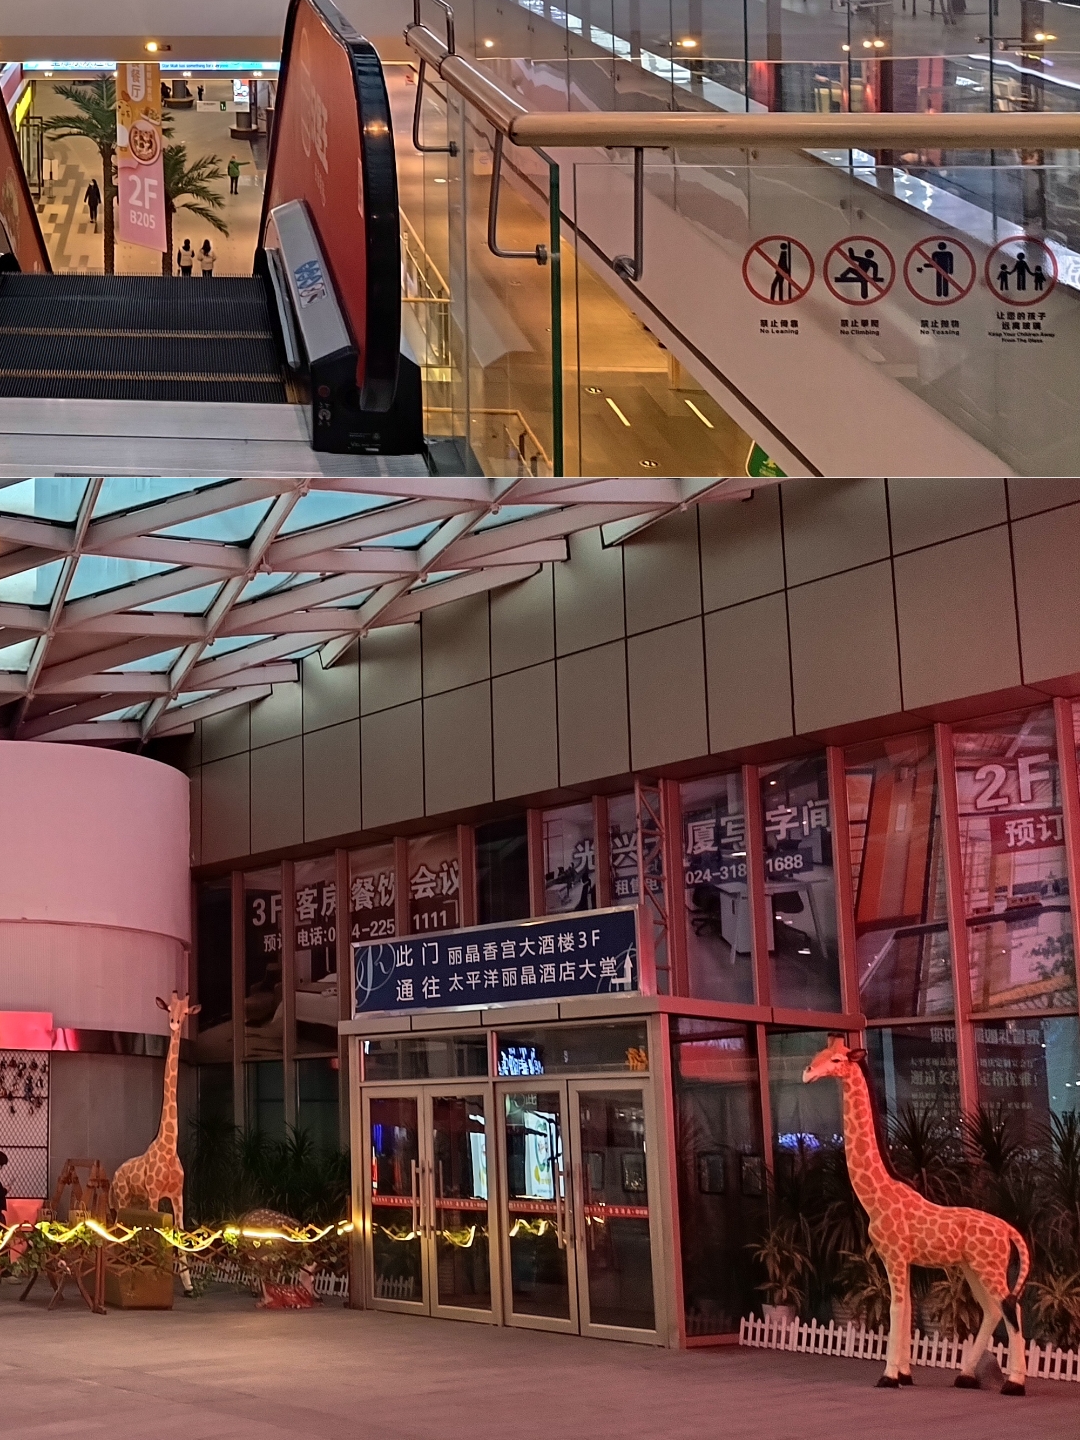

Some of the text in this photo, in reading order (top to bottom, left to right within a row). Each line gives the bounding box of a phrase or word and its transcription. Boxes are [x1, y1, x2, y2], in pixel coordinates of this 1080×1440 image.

[128, 174, 158, 210] 2F
[129, 209, 156, 229] B205
[760, 319, 799, 328] 禁止倚靠
[840, 319, 879, 328] 禁止攀爬
[996, 311, 1046, 320] 让您的孩子
[1002, 321, 1042, 330] 远离玻璃
[974, 752, 1050, 810] 2F
[351, 872, 396, 912] 餐饮
[410, 859, 459, 901] 会议
[395, 941, 439, 968] 此门
[396, 956, 618, 1003] 通往 太平洋丽晶酒店大堂
